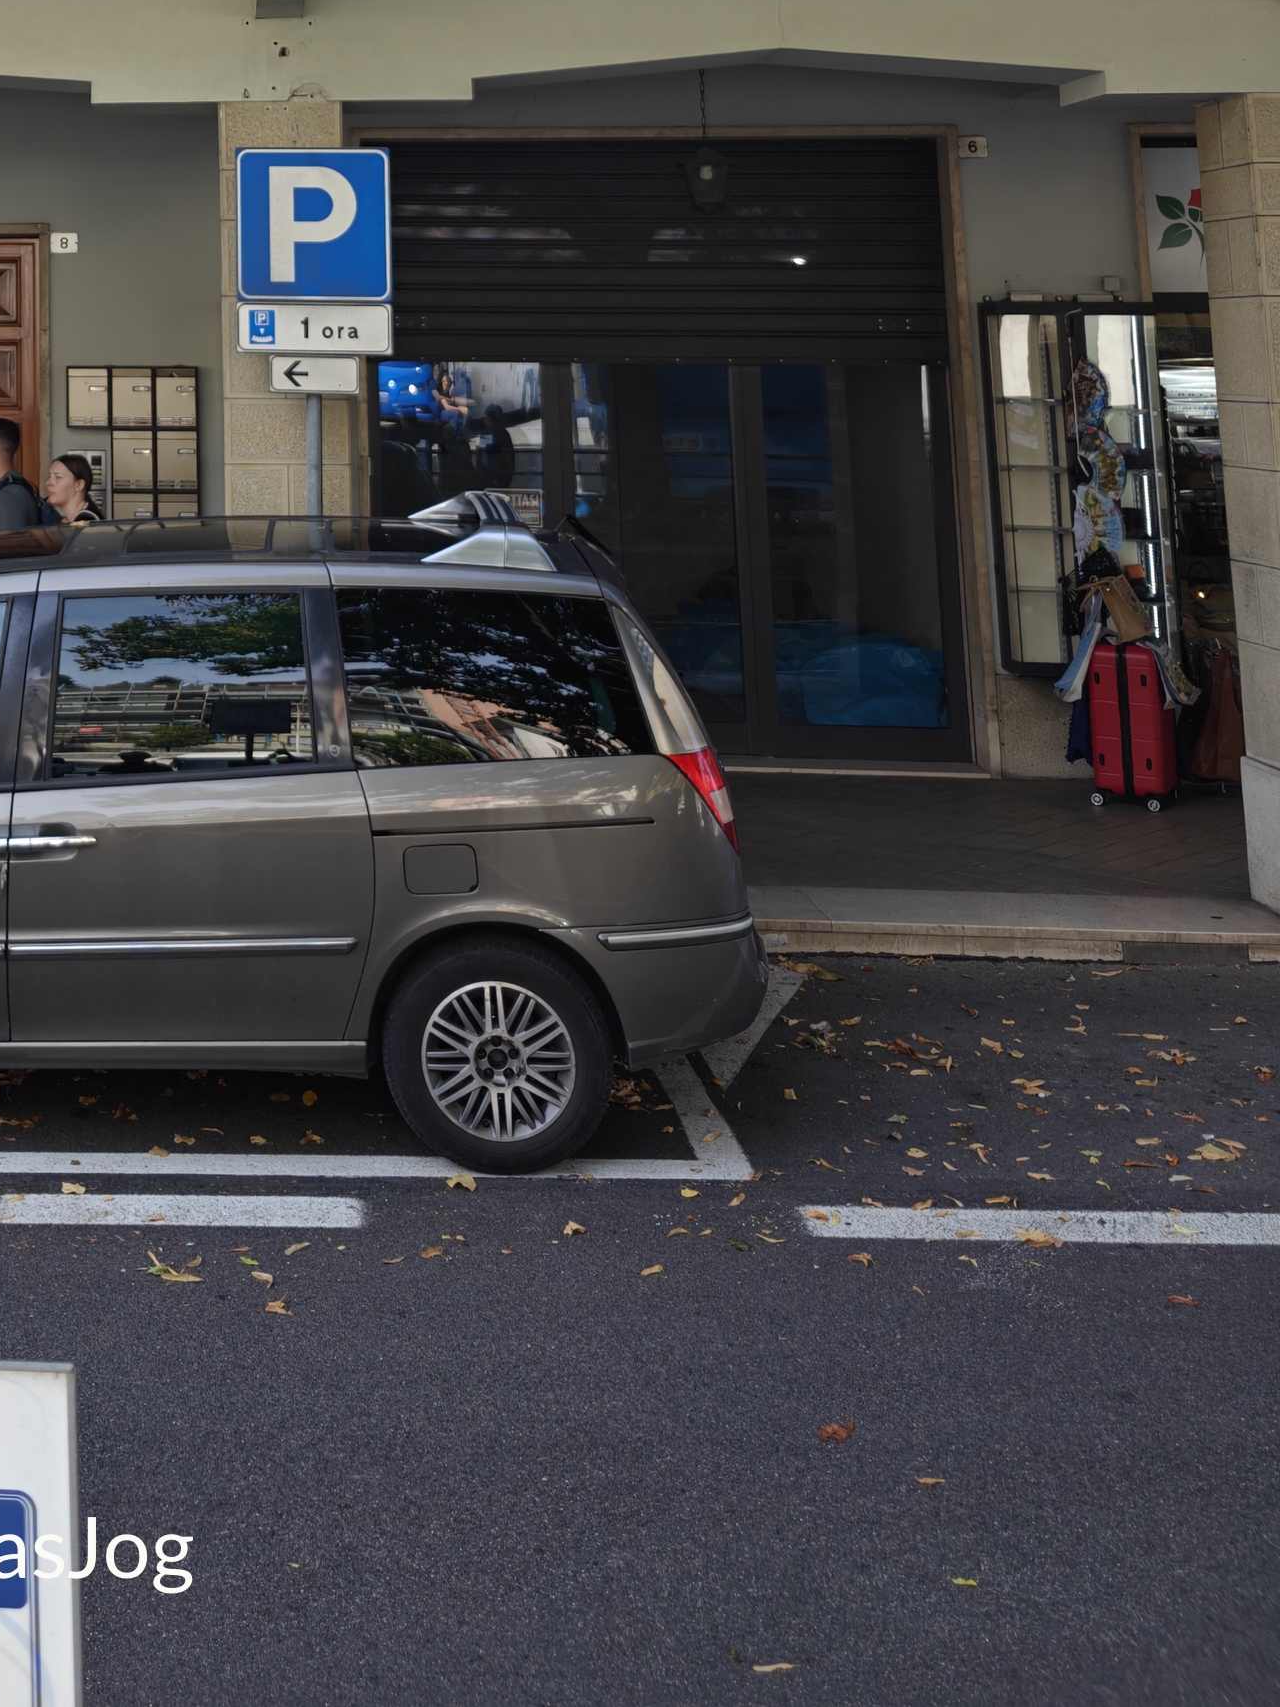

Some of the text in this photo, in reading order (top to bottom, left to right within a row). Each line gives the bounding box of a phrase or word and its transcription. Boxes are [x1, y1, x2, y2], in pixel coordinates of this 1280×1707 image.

[968, 140, 978, 154] 6
[269, 165, 358, 283] P
[60, 236, 69, 250] 8
[300, 316, 359, 340] 1 ora
